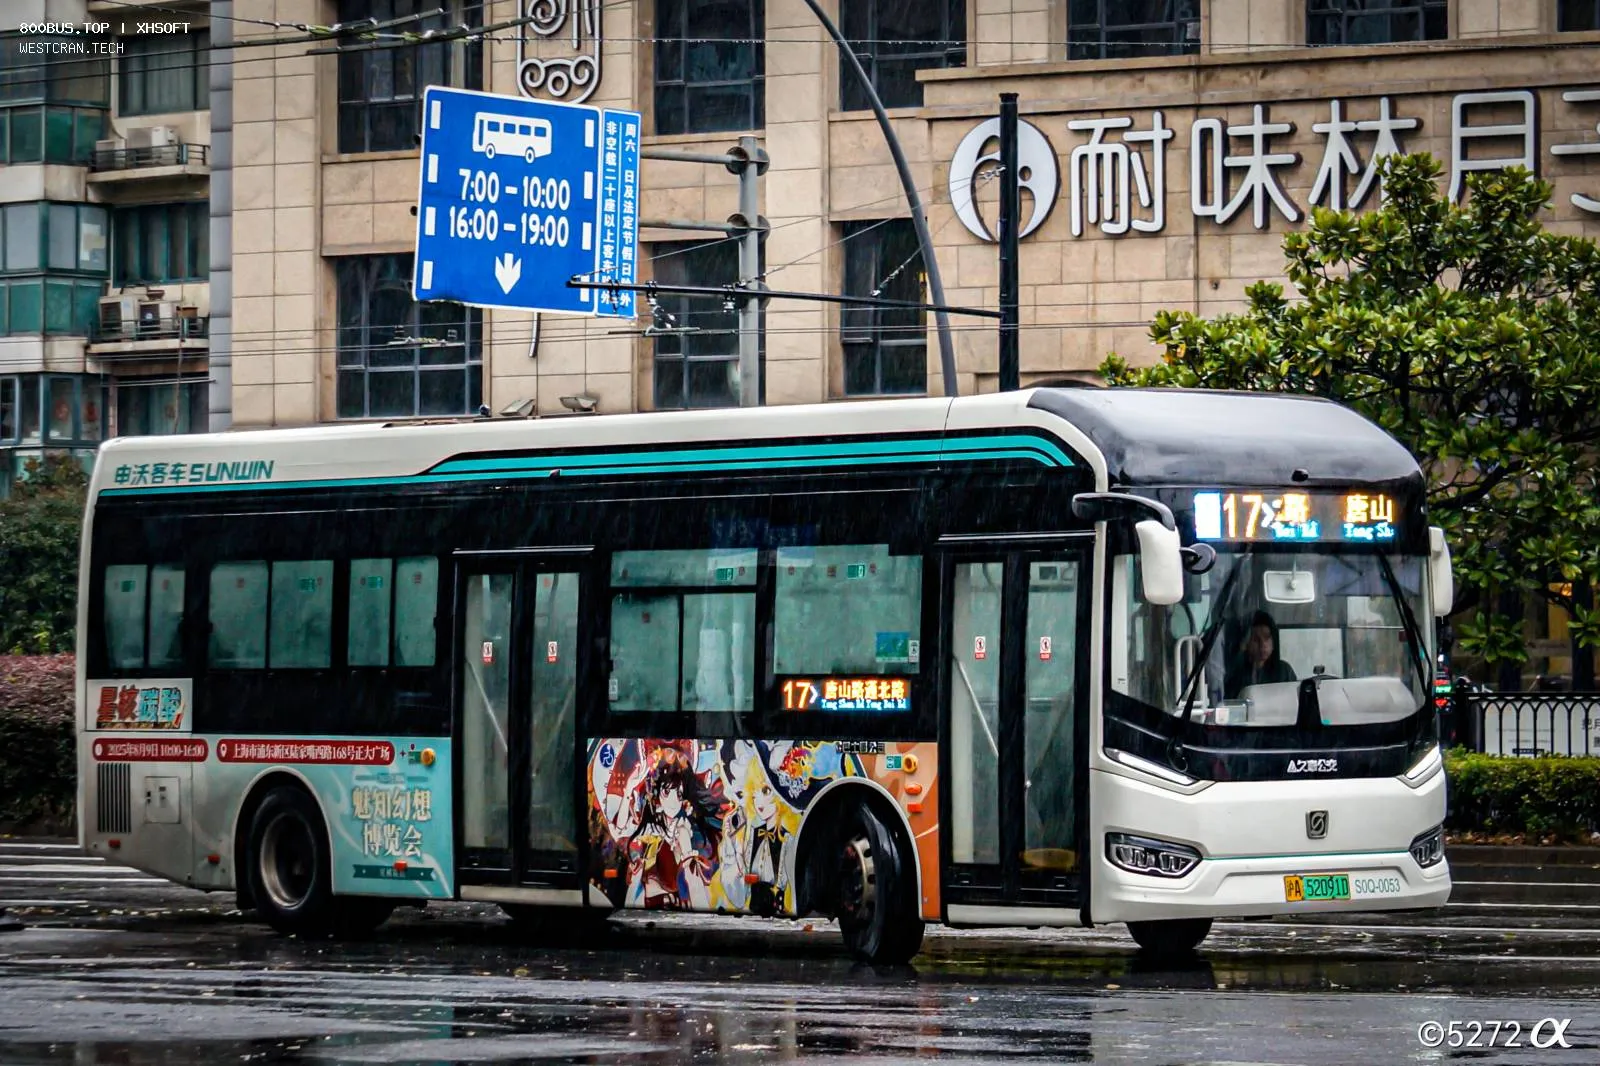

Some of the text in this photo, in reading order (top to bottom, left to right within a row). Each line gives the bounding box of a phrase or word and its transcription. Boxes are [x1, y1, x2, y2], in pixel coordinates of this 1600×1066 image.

[114, 460, 274, 485] 申沃客车 SUNWIN
[1223, 493, 1263, 538] 17
[783, 680, 812, 710] 17
[362, 823, 422, 857] 博览会
